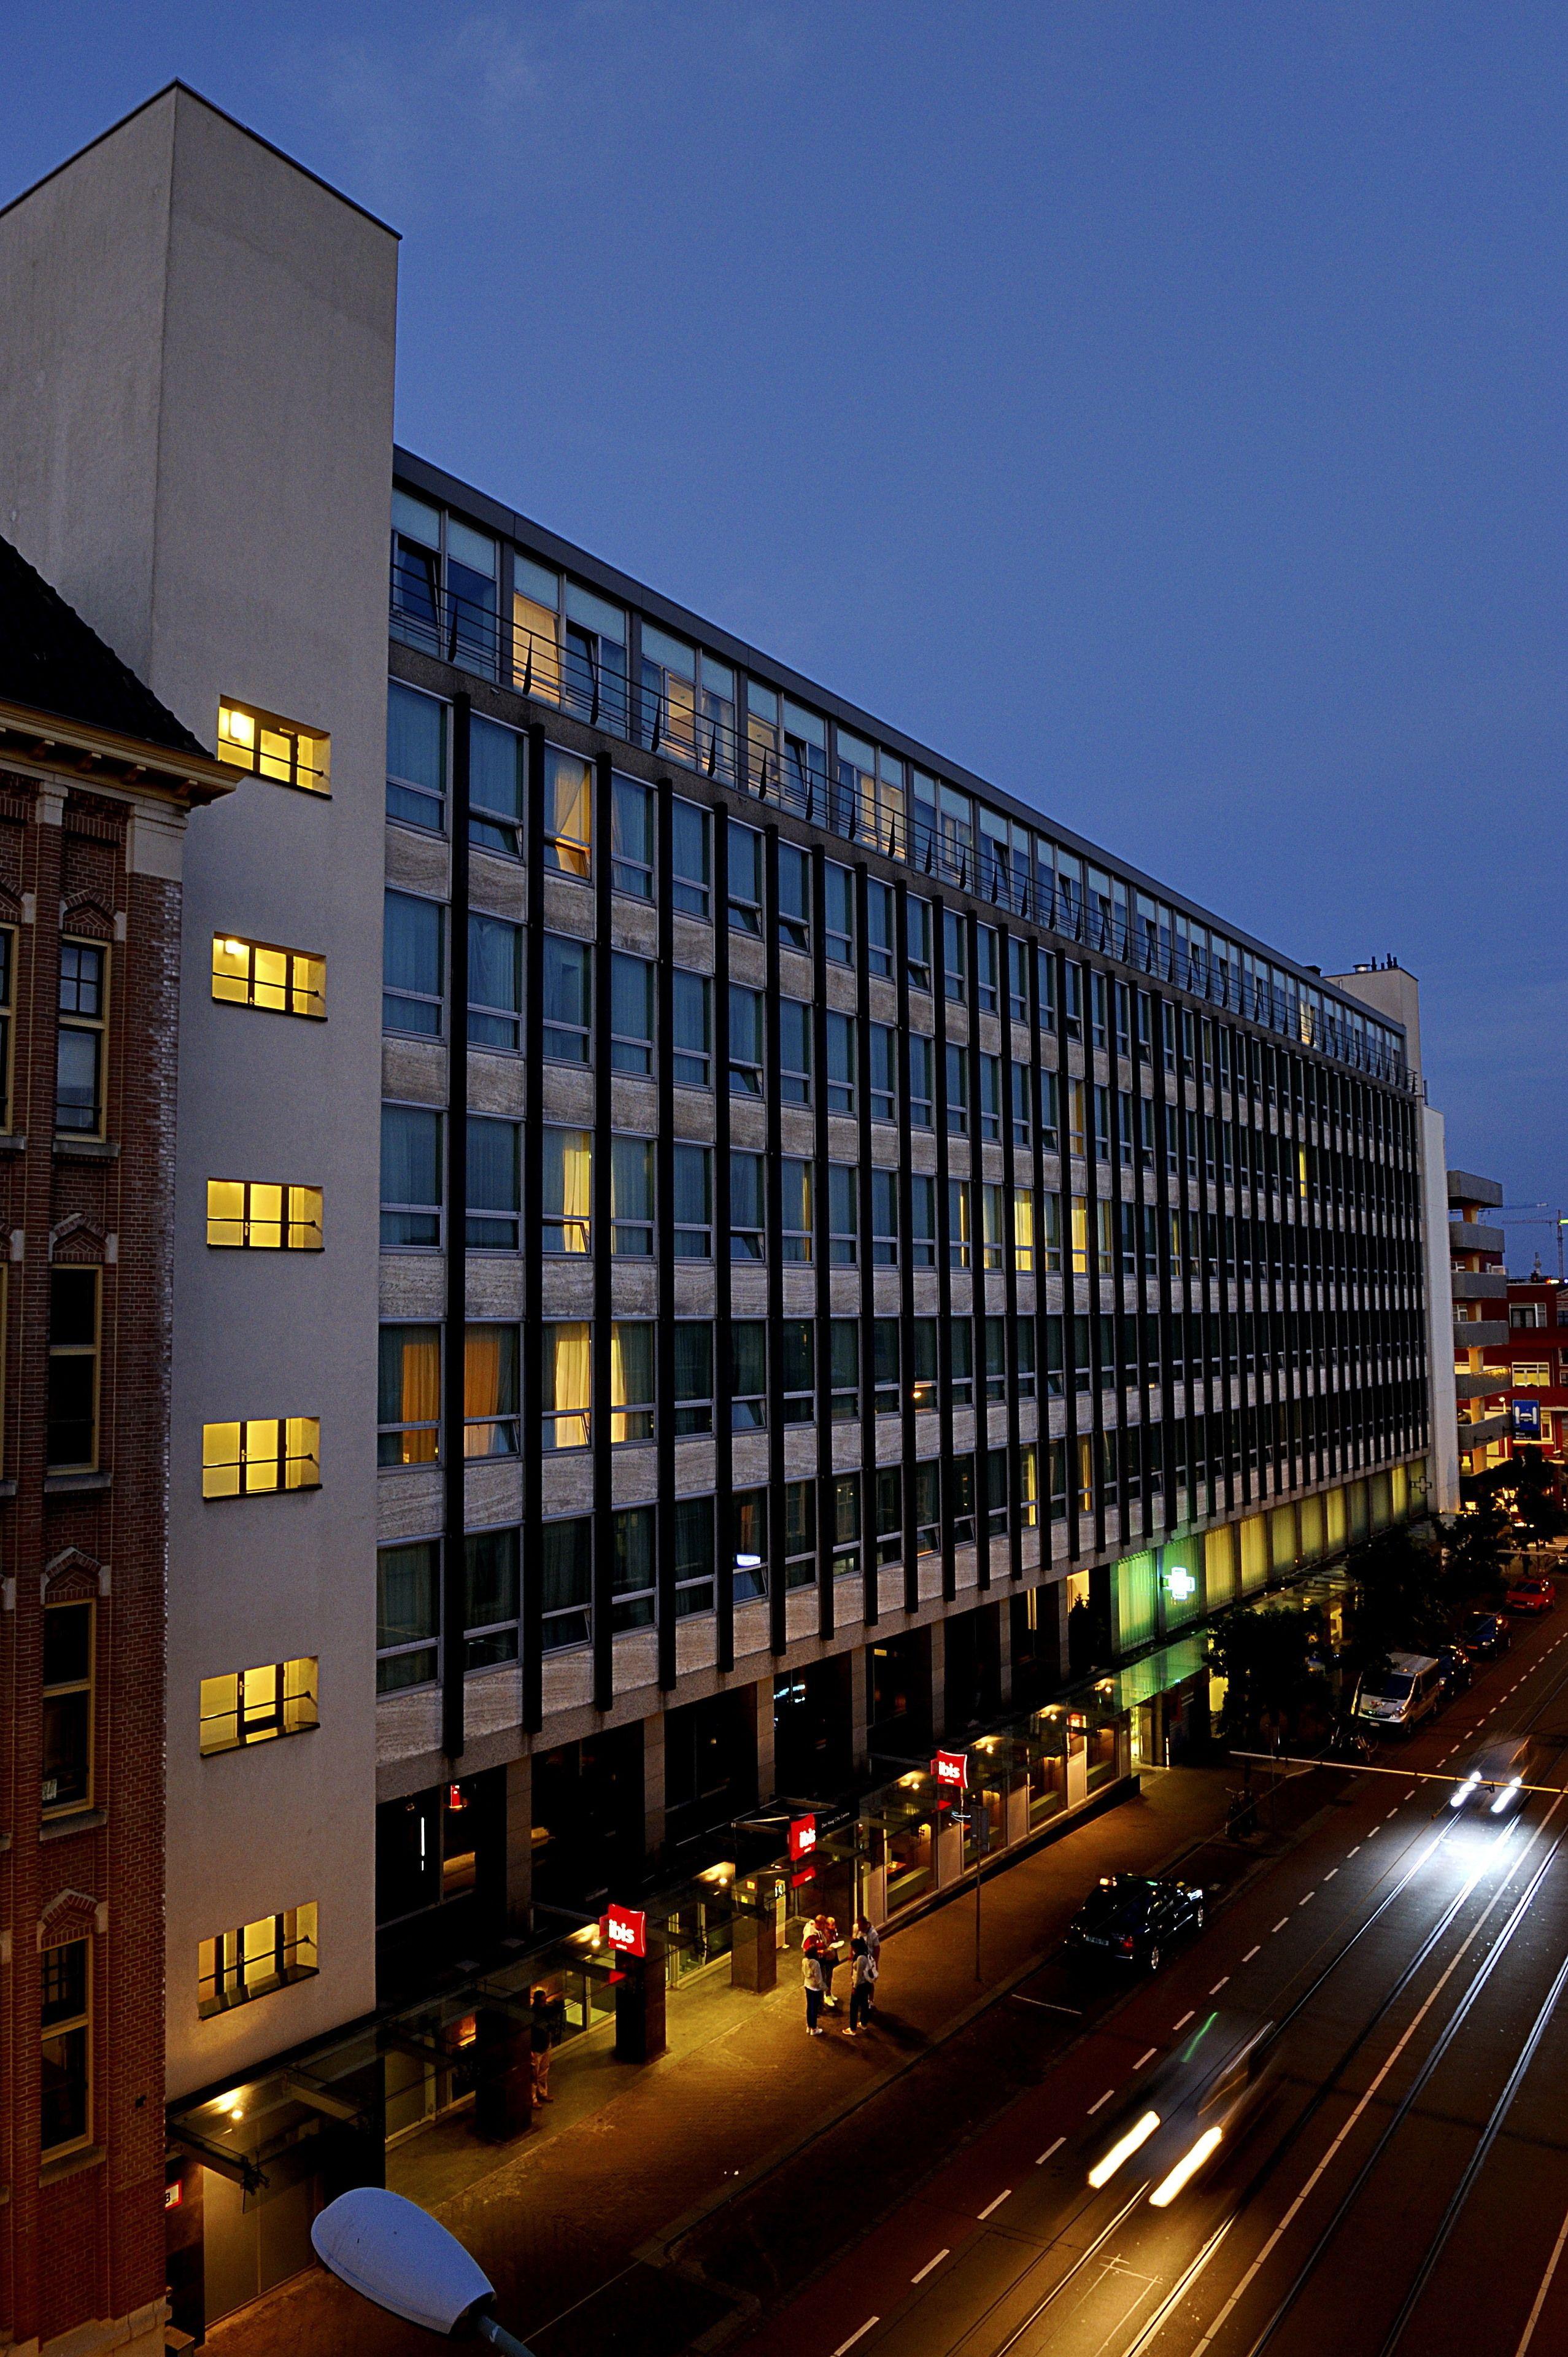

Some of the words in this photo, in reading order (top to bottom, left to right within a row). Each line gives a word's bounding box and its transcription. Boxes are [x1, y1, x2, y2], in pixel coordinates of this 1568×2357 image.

[938, 1760, 960, 1779] ibis
[799, 1828, 816, 1848] ibis
[609, 1919, 635, 1943] ibis
